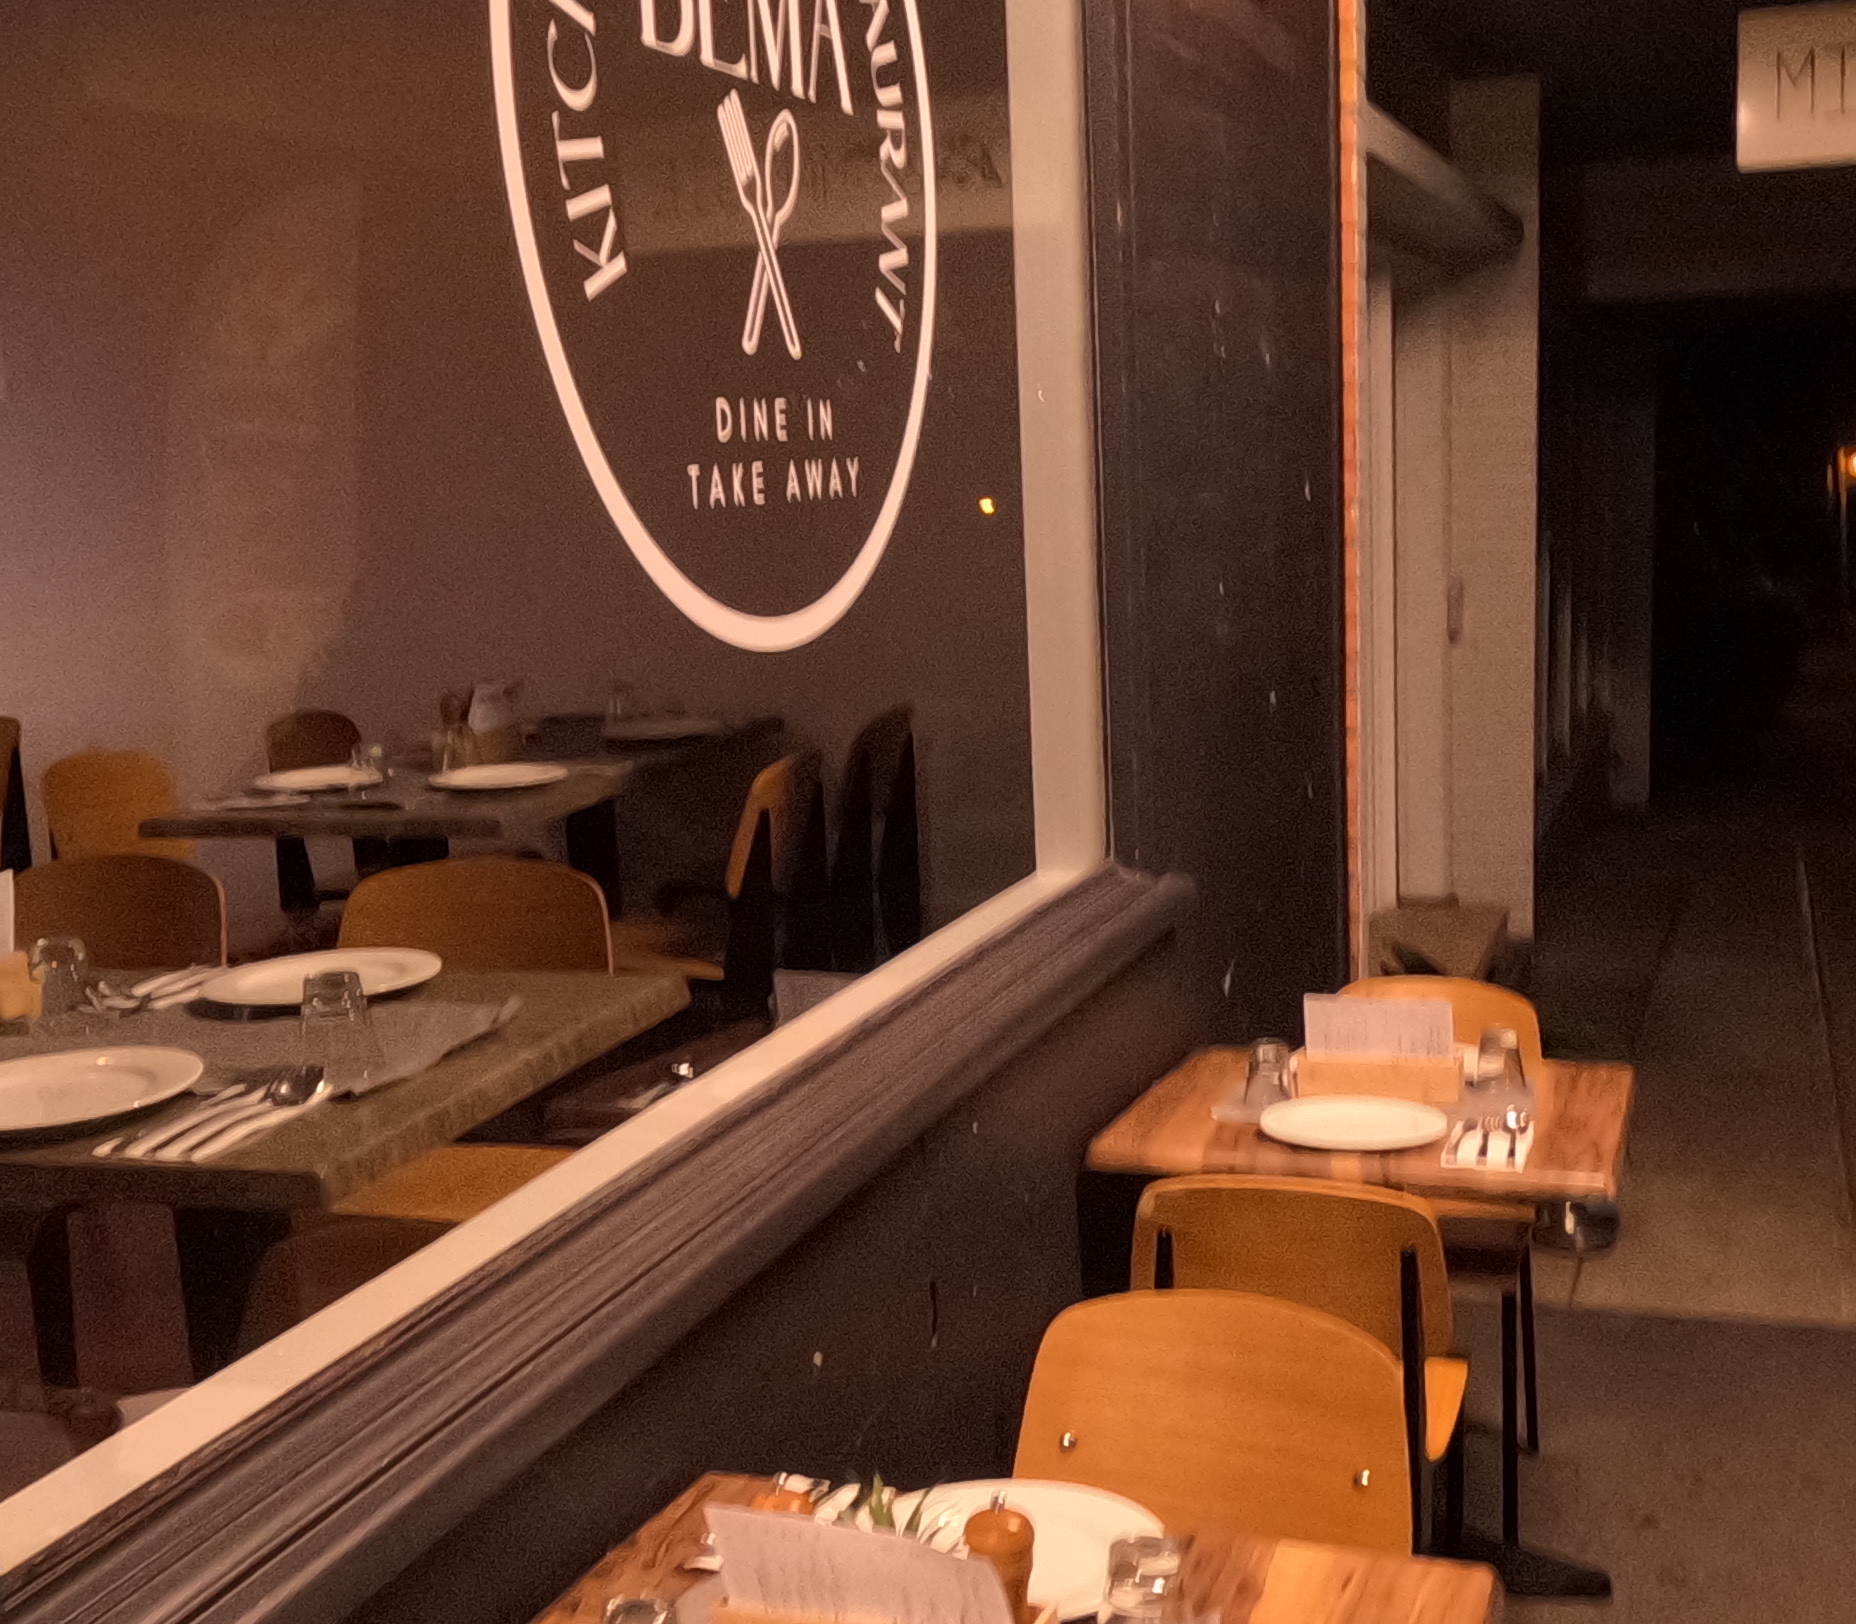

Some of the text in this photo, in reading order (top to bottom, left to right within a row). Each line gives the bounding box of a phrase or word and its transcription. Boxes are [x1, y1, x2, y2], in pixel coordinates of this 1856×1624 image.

[714, 396, 834, 443] DINE IN
[686, 457, 861, 509] TAKE AWAY
